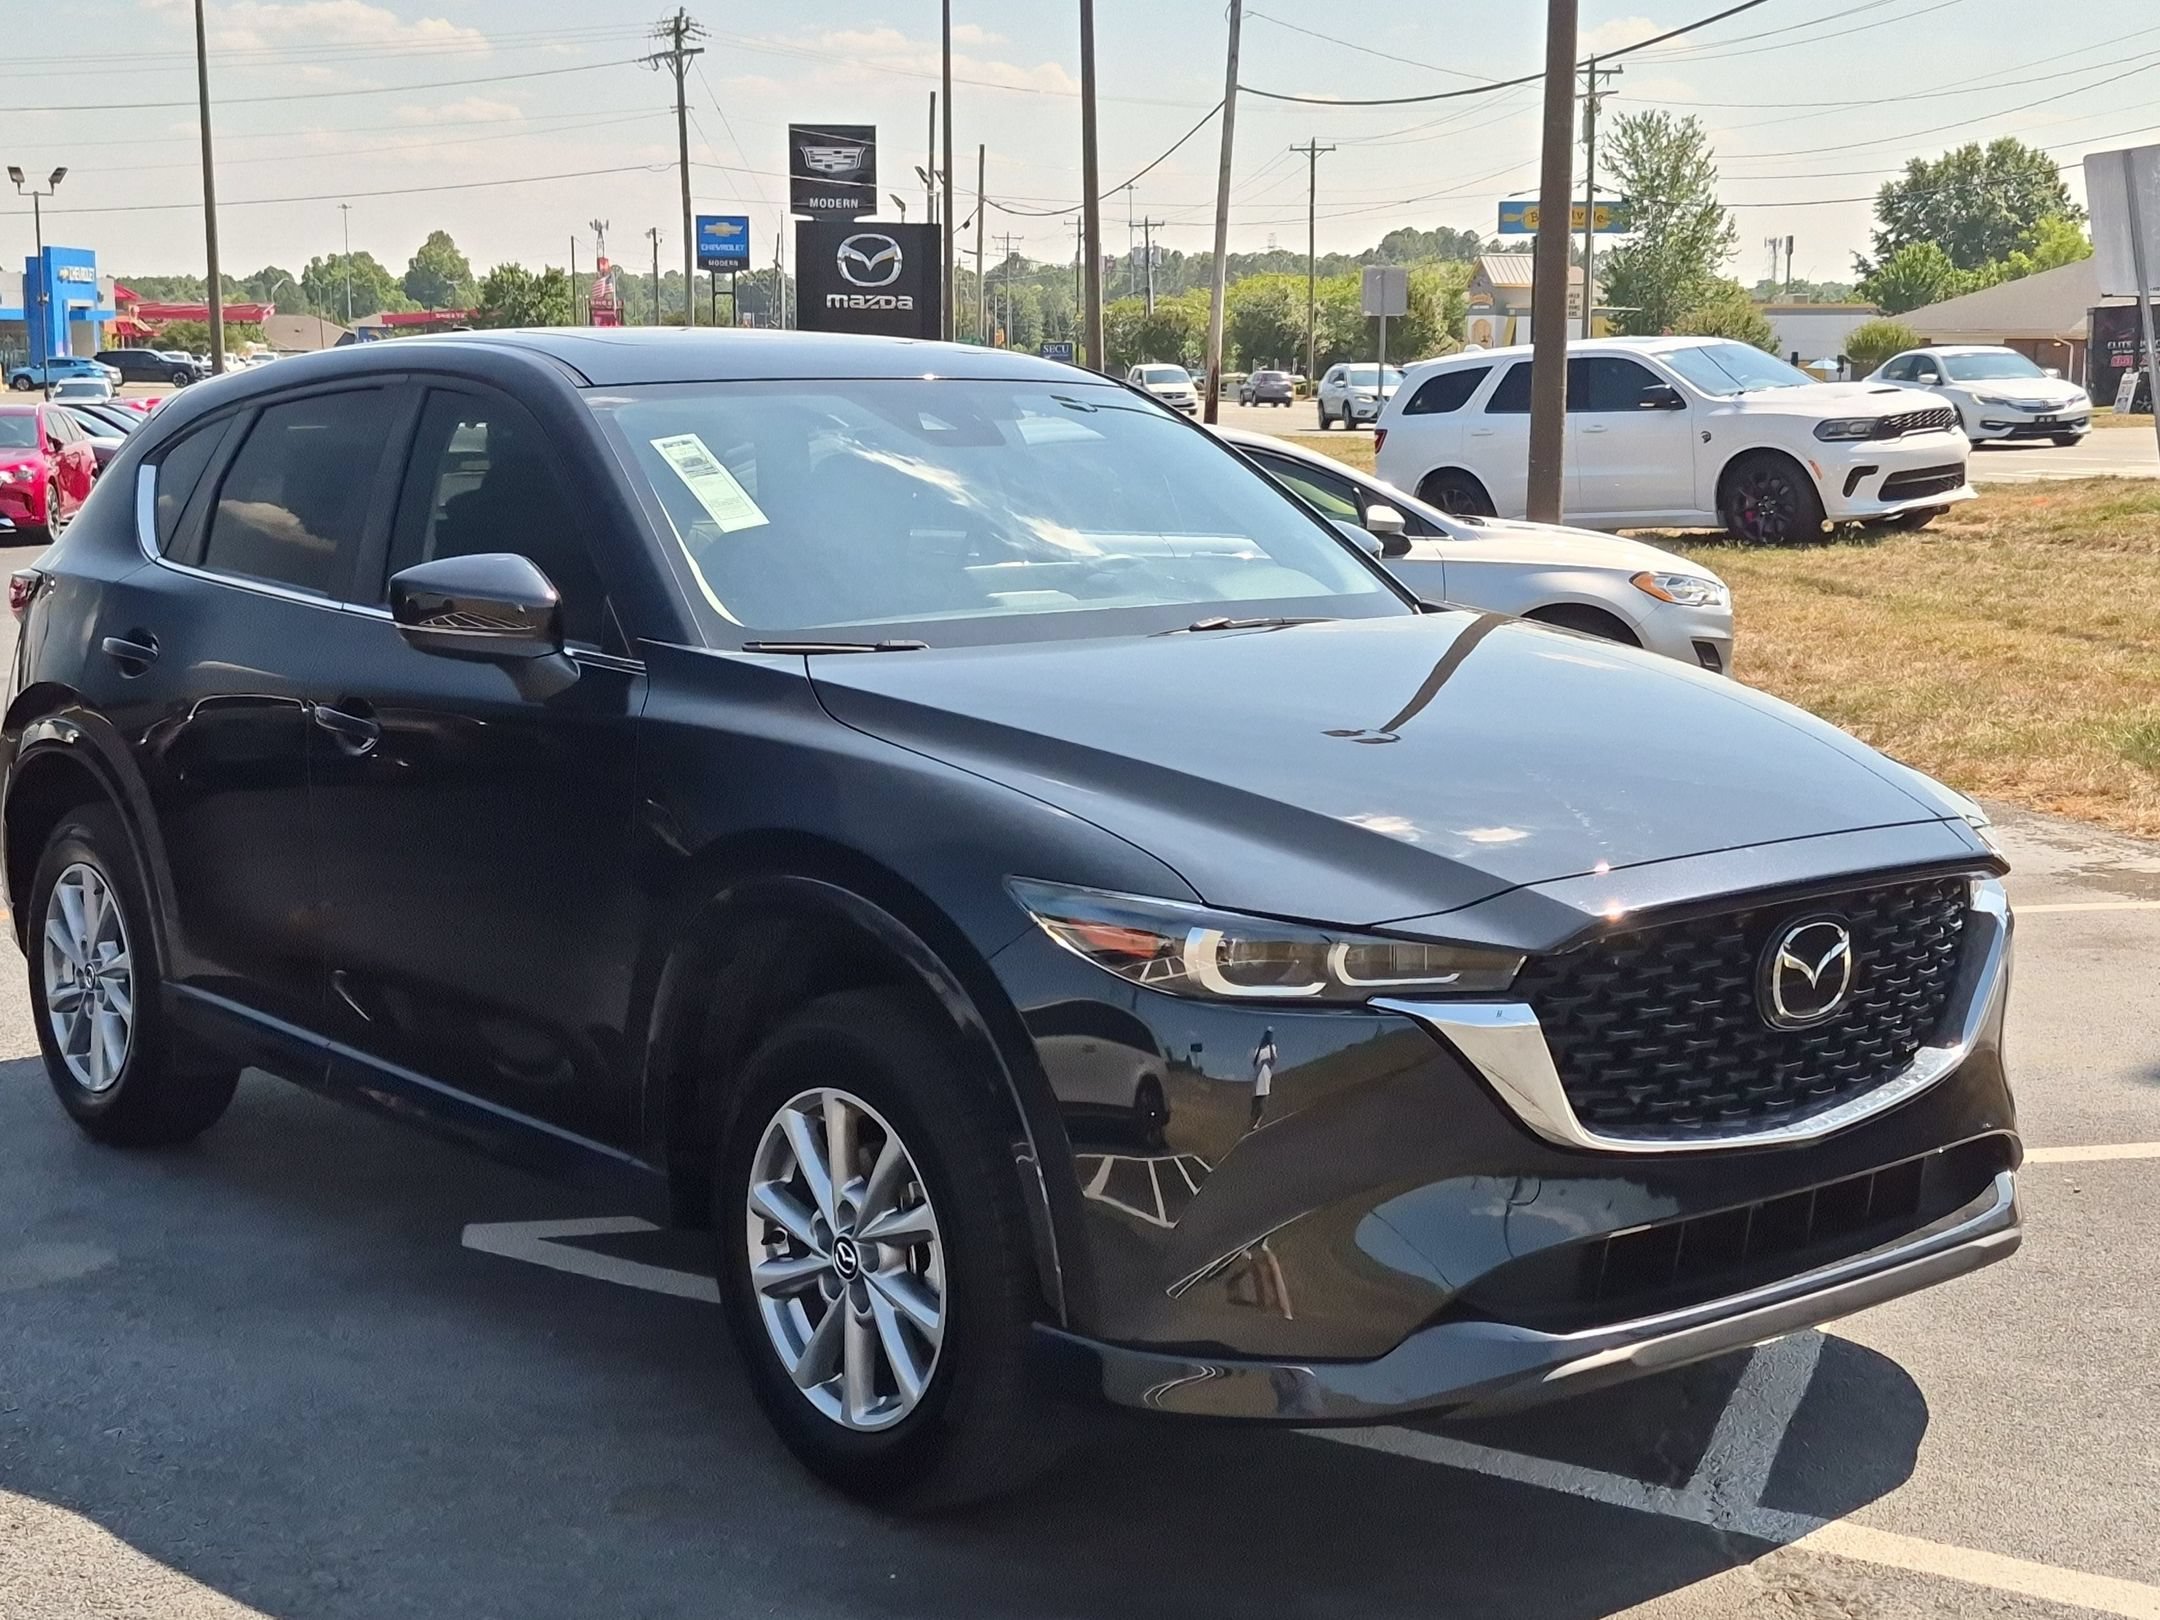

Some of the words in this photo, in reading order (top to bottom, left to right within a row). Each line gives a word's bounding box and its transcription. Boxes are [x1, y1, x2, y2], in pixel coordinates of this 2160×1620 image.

[809, 198, 859, 209] MODERN
[700, 243, 745, 252] CHEVROLET
[708, 259, 739, 267] MODERN
[826, 294, 914, 310] mazda
[1043, 344, 1069, 353] SECU
